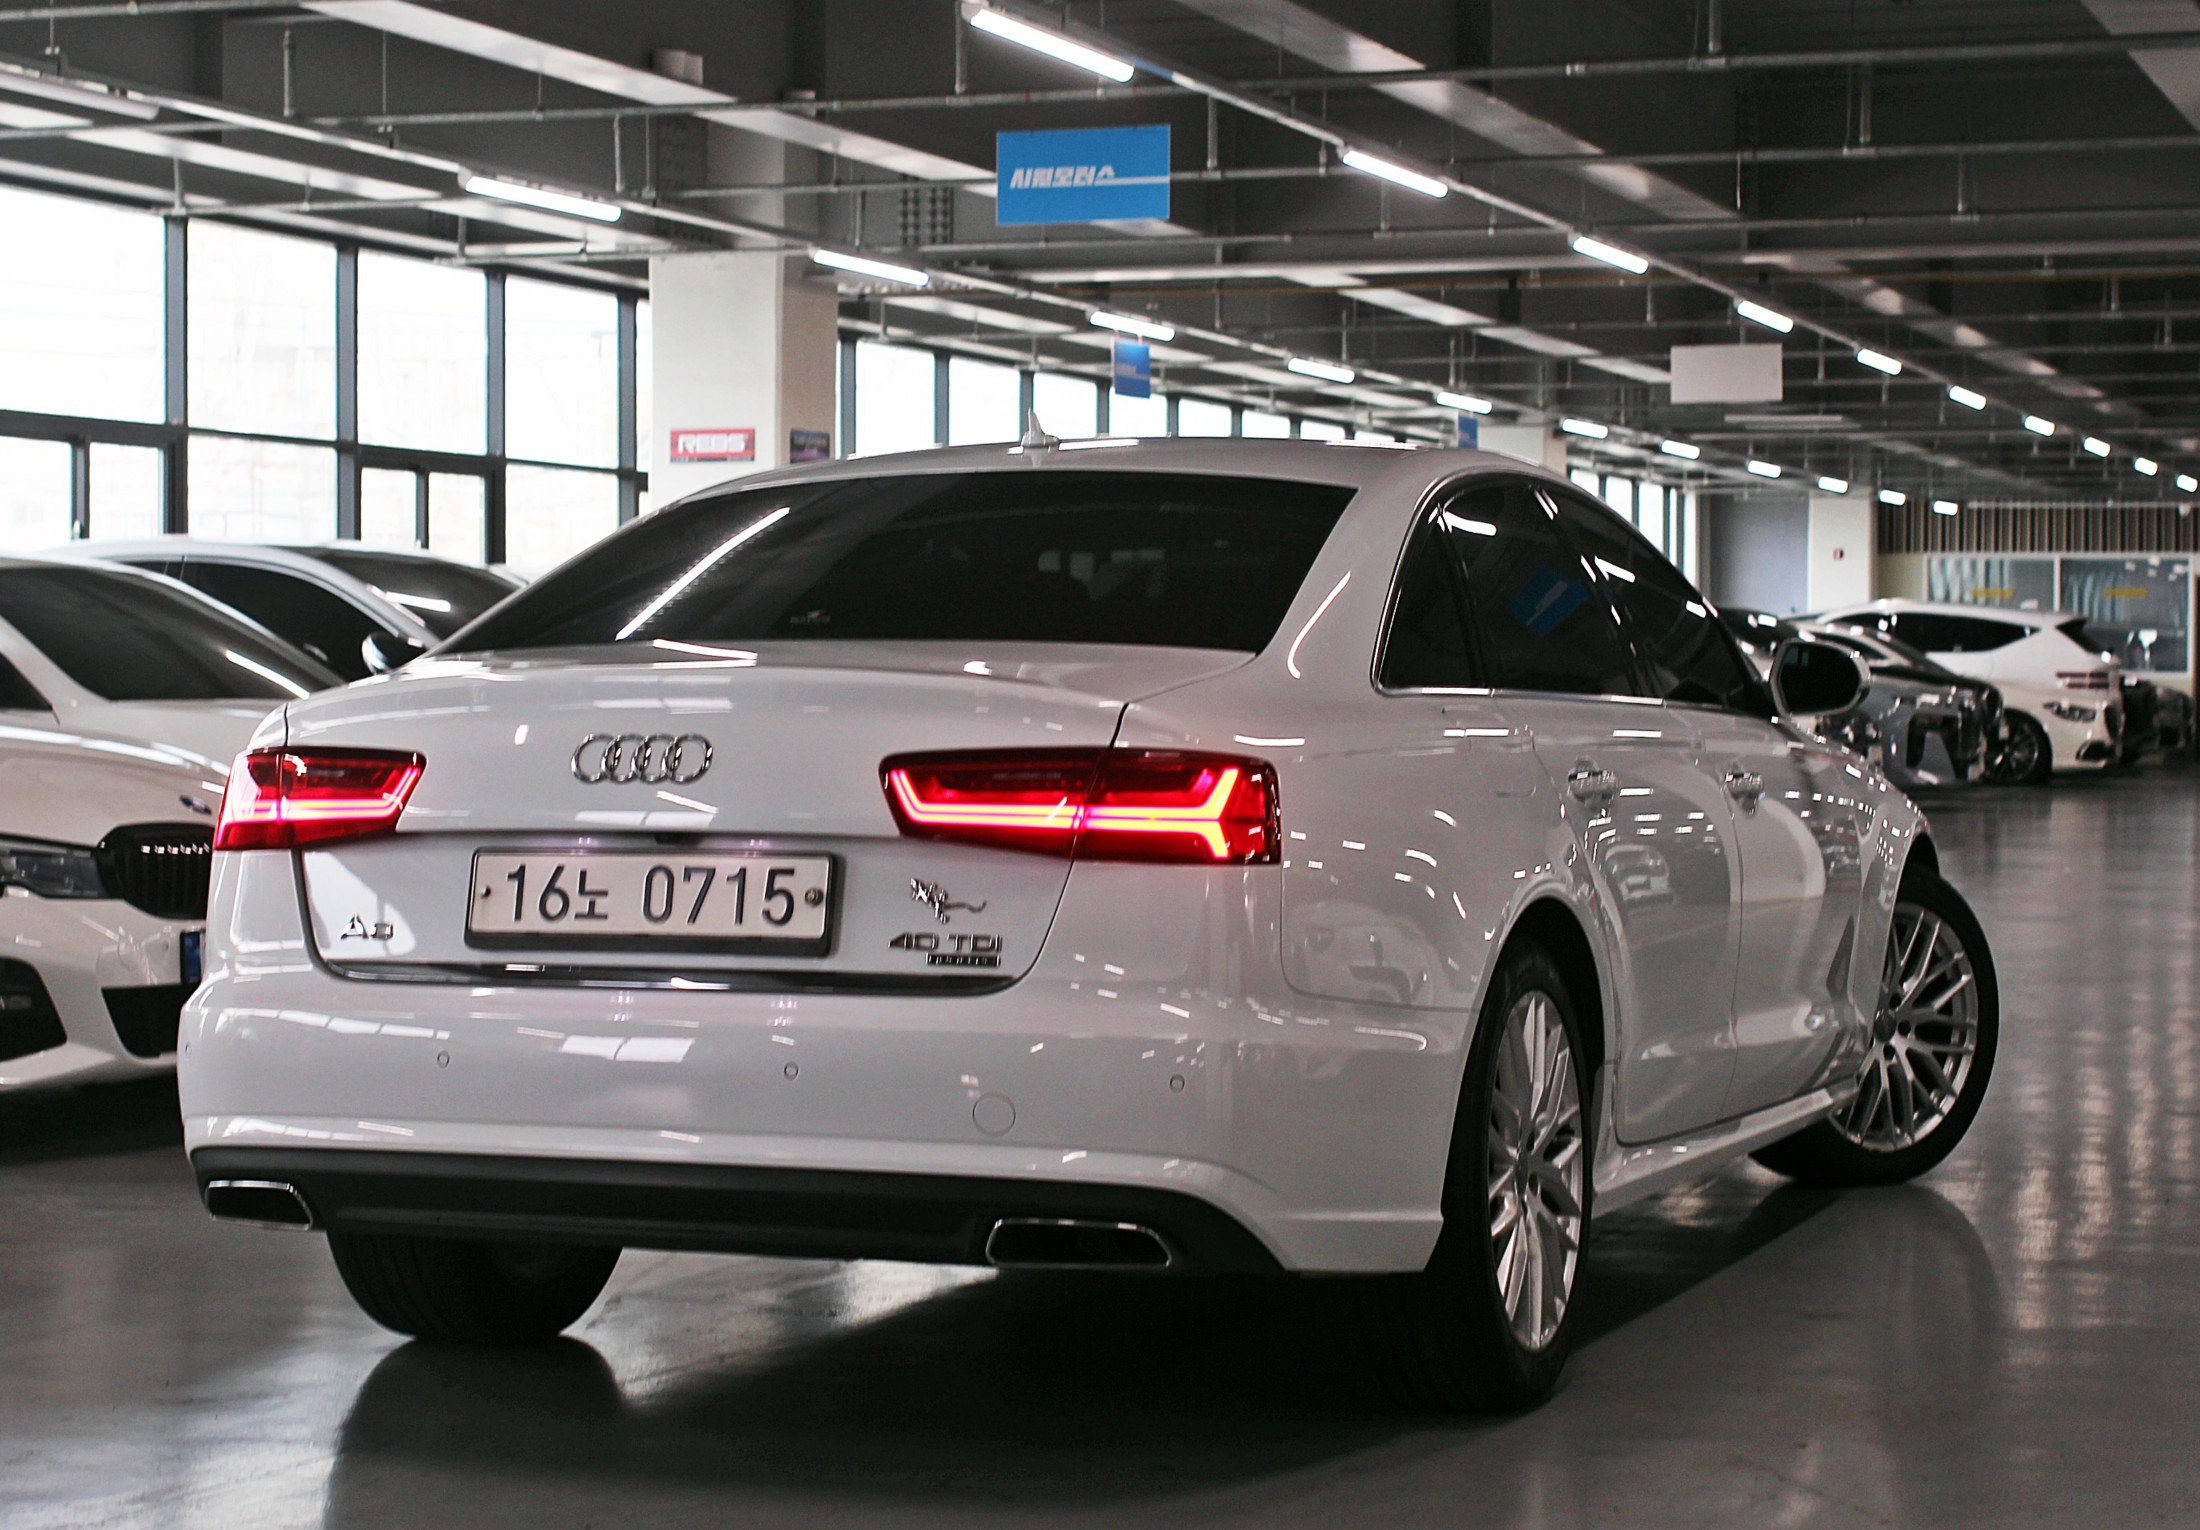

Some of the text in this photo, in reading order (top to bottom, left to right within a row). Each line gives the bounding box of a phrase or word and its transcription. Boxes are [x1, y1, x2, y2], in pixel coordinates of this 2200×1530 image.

[507, 864, 796, 926] 16노 0715
[888, 931, 1003, 953] 40 TDI
